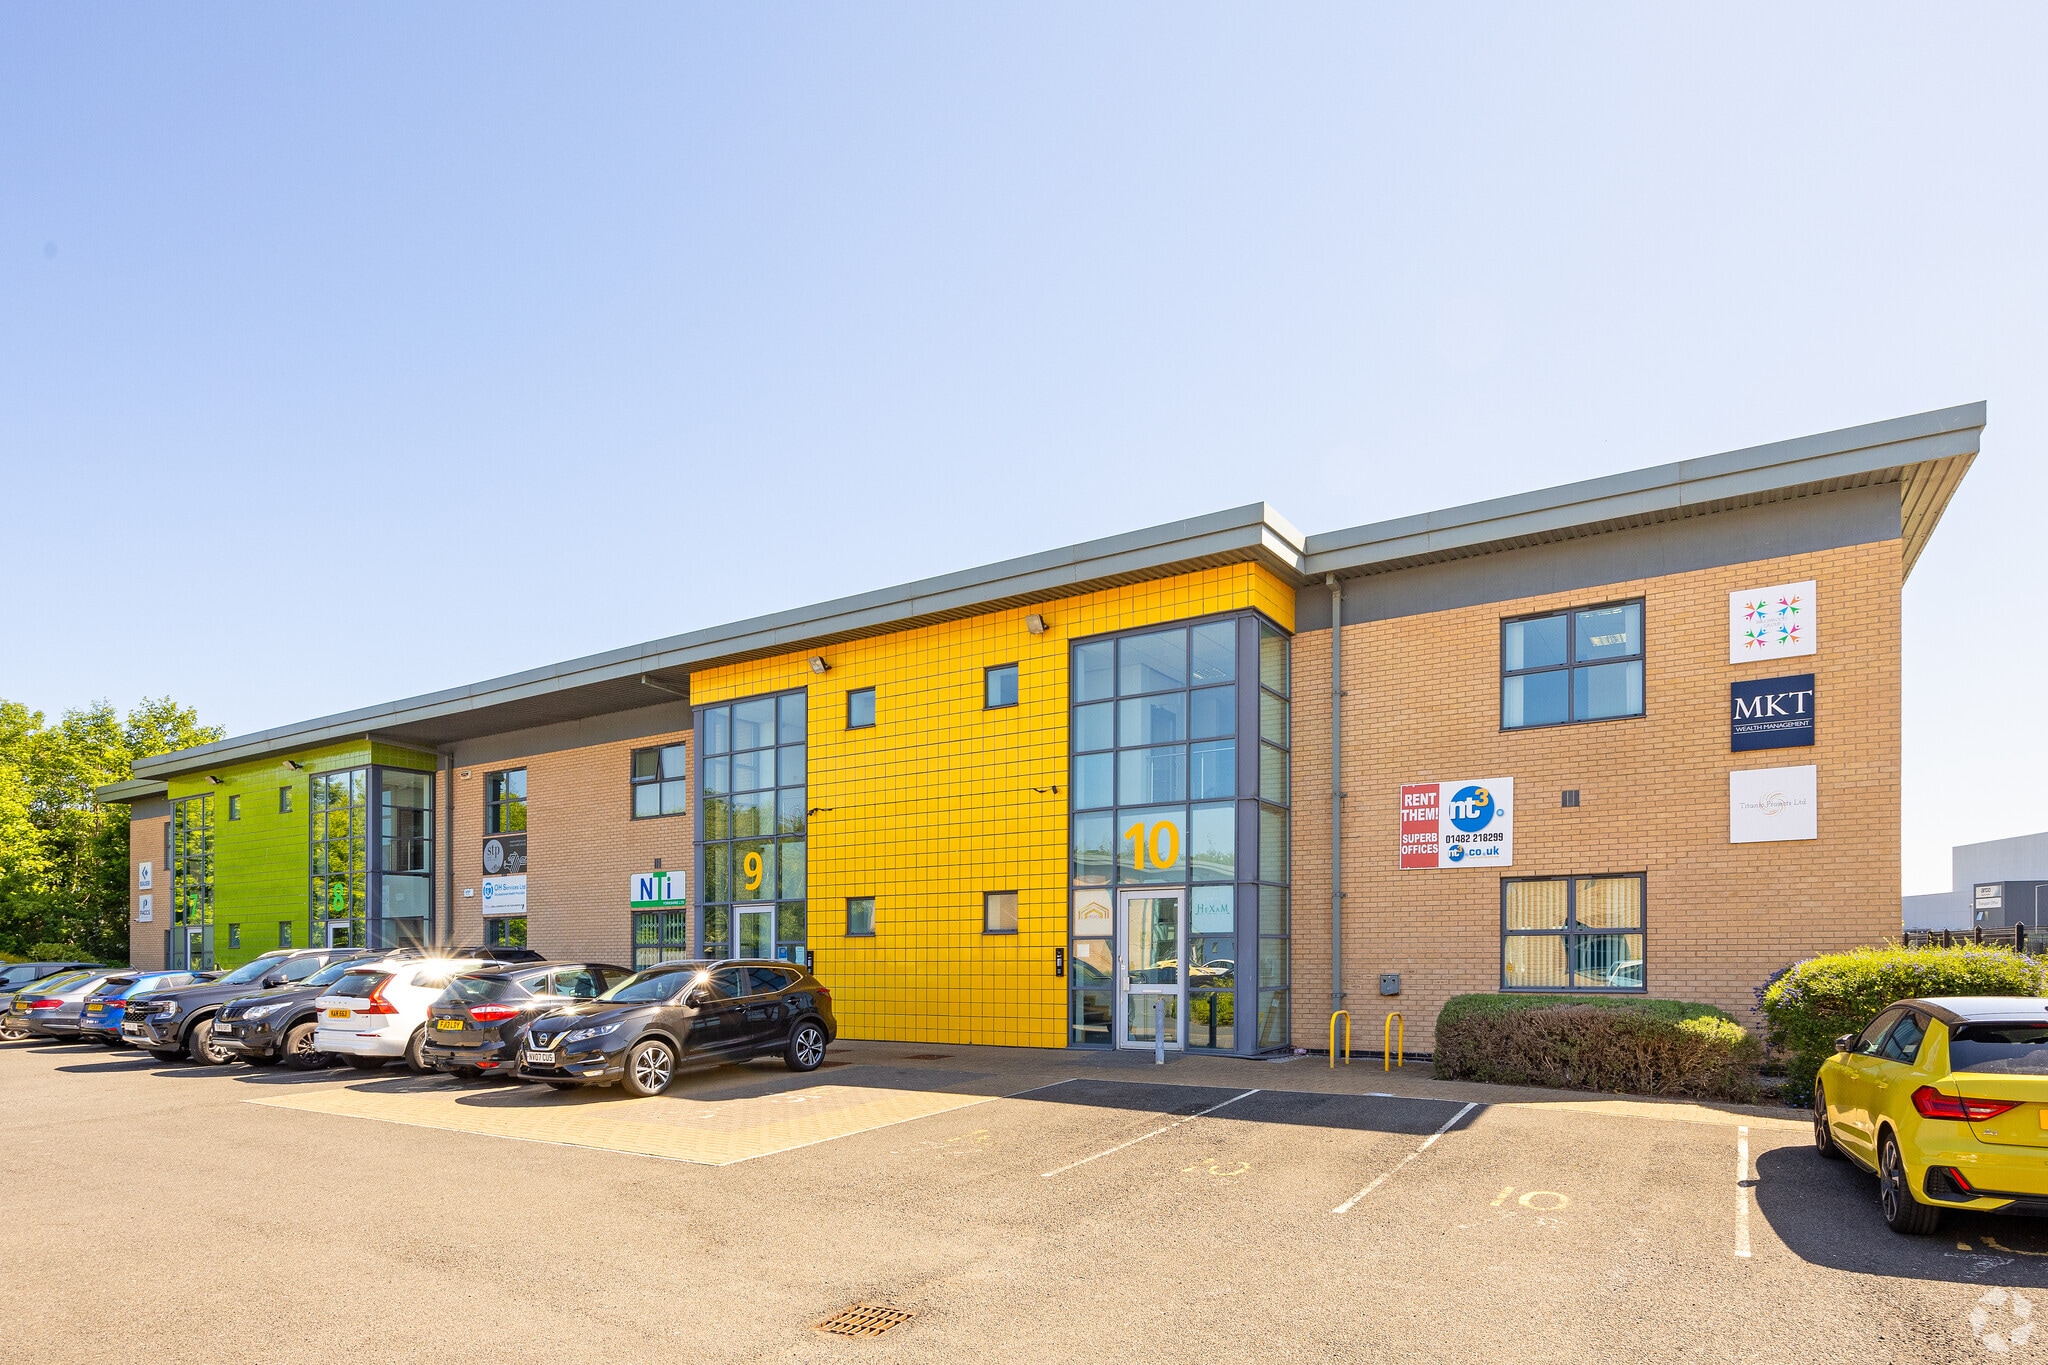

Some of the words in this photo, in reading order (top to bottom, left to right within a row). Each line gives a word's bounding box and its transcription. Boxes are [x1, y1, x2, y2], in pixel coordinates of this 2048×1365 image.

[1733, 691, 1812, 720] MKT
[1735, 723, 1763, 733] WEALTH
[1763, 720, 1809, 731] MANAGEMENT
[1405, 793, 1437, 807] RENT
[1794, 798, 1807, 806] Ltd
[1401, 807, 1439, 822] THEM!
[1123, 820, 1180, 870] 10
[1402, 833, 1438, 844] SUPERB
[1445, 834, 1471, 844] 01482
[1472, 832, 1504, 843] 218299
[487, 845, 500, 859] stp
[1401, 843, 1439, 855] OFFICES
[743, 851, 763, 891] 9
[494, 884, 502, 892] OH
[640, 871, 671, 901] NTi
[333, 883, 344, 912] 8
[189, 893, 198, 919] 7
[1489, 1186, 1572, 1211] 10
